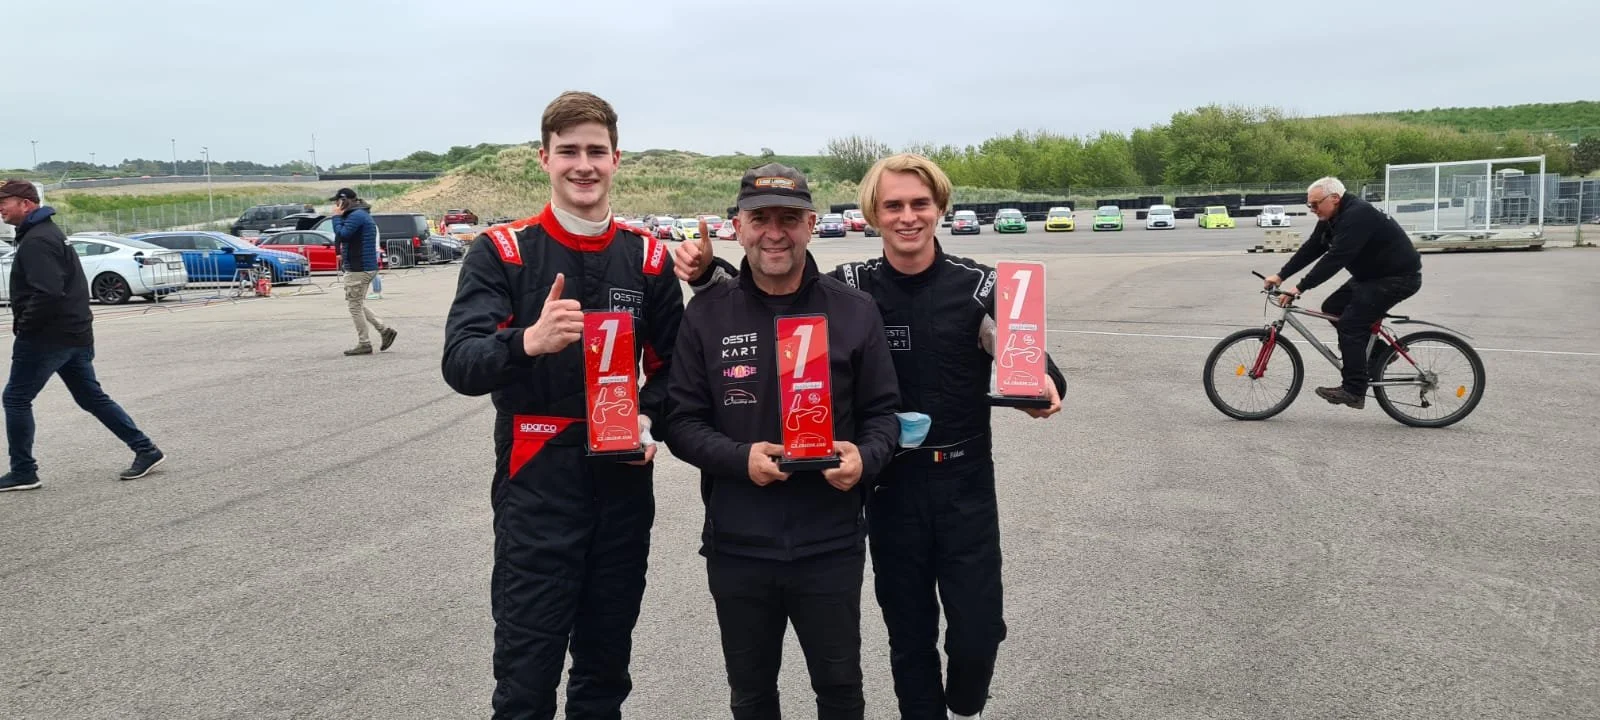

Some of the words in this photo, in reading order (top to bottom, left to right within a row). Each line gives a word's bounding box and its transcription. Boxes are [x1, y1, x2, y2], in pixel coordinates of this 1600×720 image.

[980, 270, 997, 297] sparco
[613, 292, 642, 304] OESTE
[1010, 270, 1033, 320] 1
[598, 319, 620, 373] 1
[722, 332, 758, 345] OESTE
[721, 346, 758, 359] KART
[792, 324, 814, 379] 1
[519, 423, 557, 433] sparco
